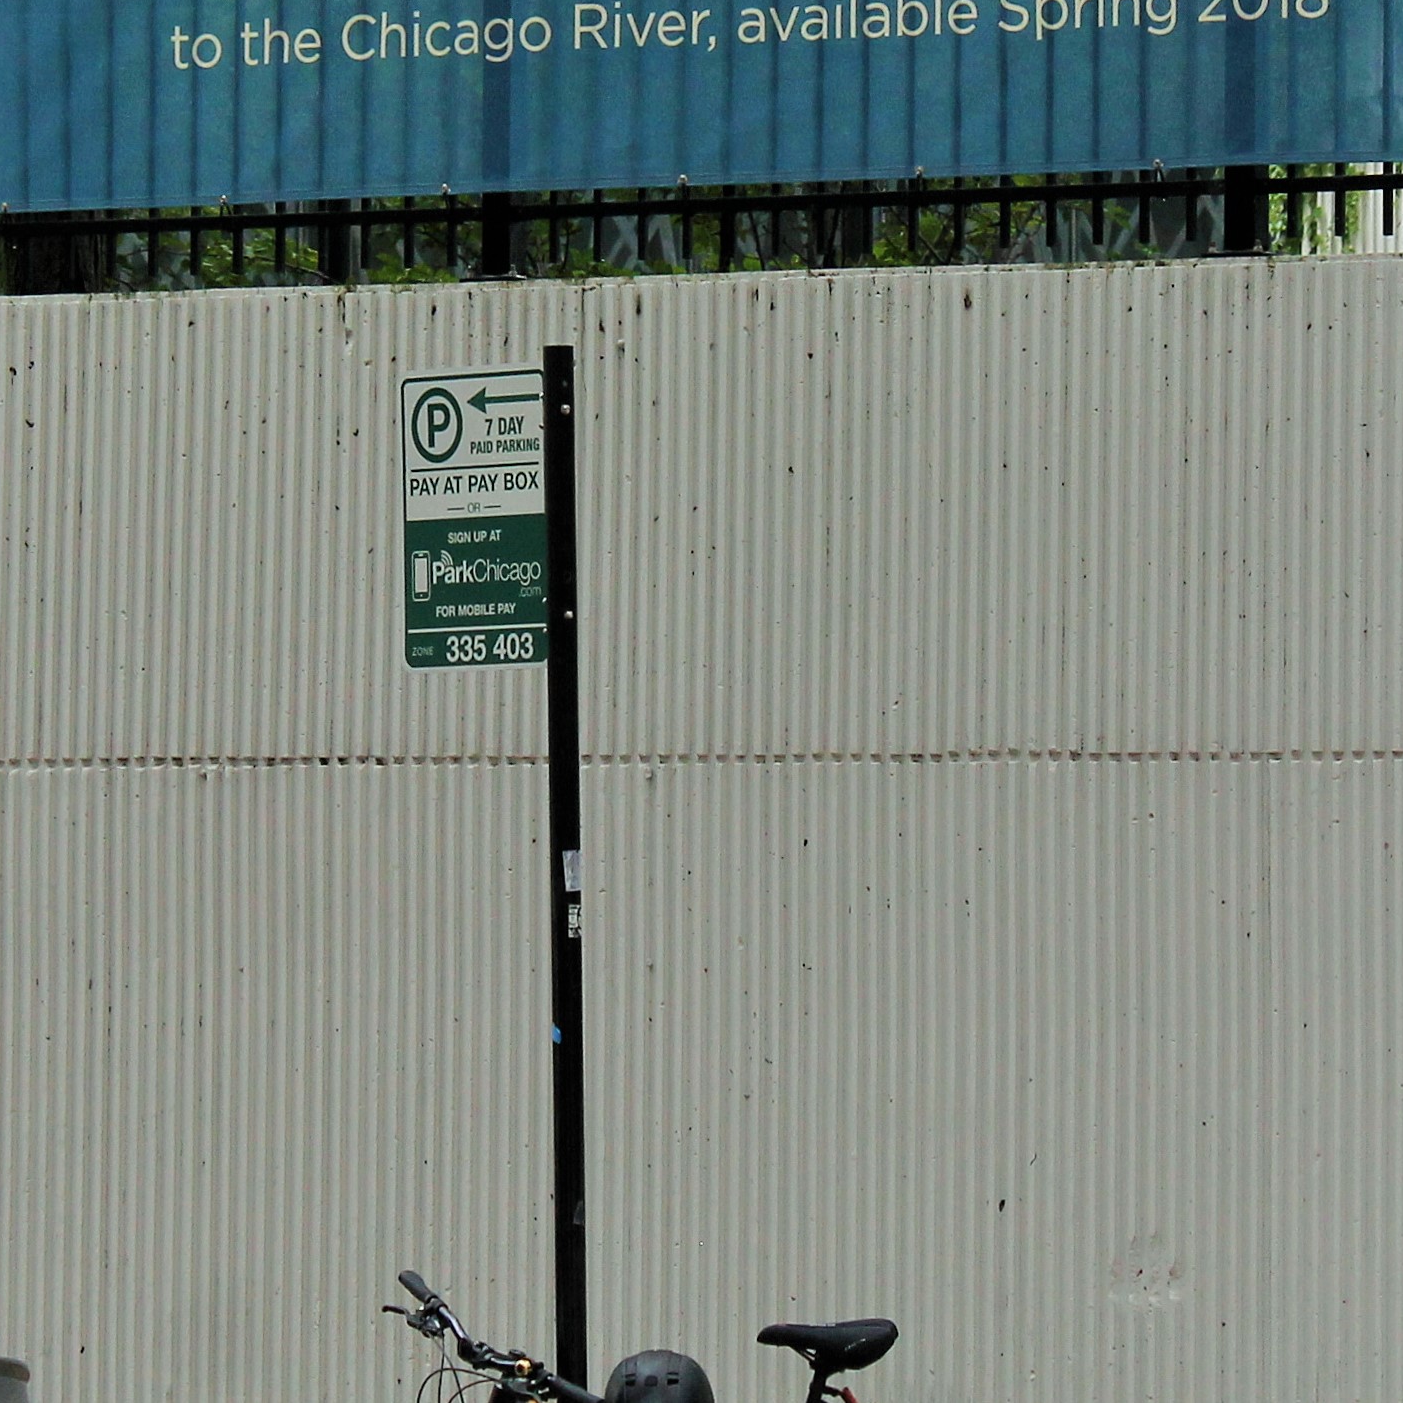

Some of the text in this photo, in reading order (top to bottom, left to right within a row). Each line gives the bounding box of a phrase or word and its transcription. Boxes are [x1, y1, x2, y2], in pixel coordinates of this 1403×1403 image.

[170, 24, 223, 70] to
[240, 17, 322, 66] the
[341, 9, 552, 63] Chicago
[573, 1, 718, 52] River,
[427, 403, 451, 448] P
[485, 416, 524, 436] 7 DAY
[470, 437, 540, 455] PAID PARKING
[409, 471, 539, 497] PAY AT PAY BOX
[467, 502, 481, 513] OR
[447, 529, 502, 544] SIGN UP AT
[432, 559, 542, 586] ParkChicago
[436, 602, 516, 617] FOR MOBILE PAY
[411, 632, 534, 662] ZONE 335 403
